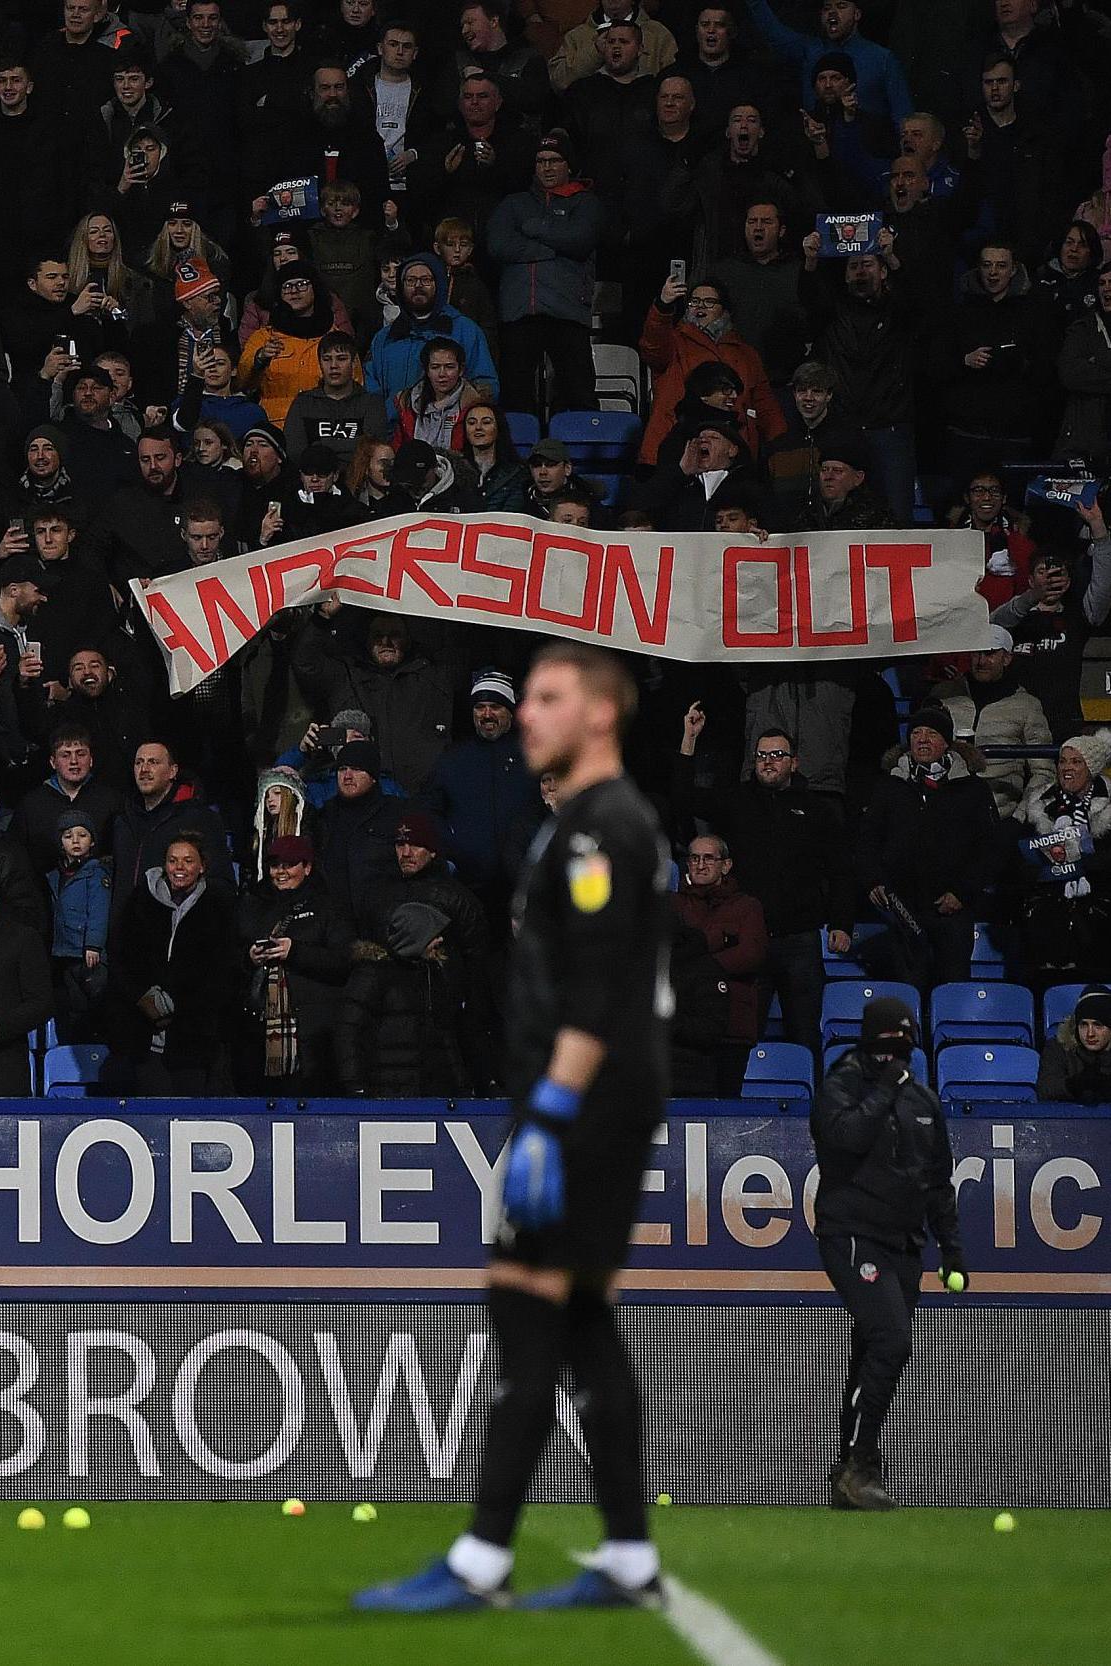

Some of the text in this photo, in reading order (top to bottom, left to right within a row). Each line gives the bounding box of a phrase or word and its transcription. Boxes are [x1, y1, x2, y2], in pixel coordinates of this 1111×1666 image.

[269, 179, 310, 193] NDERSON
[825, 214, 875, 224] ANDERSON
[319, 422, 358, 439] EA7
[146, 519, 932, 674] ANDERSON OUT
[1029, 827, 1081, 850] ANDERSON
